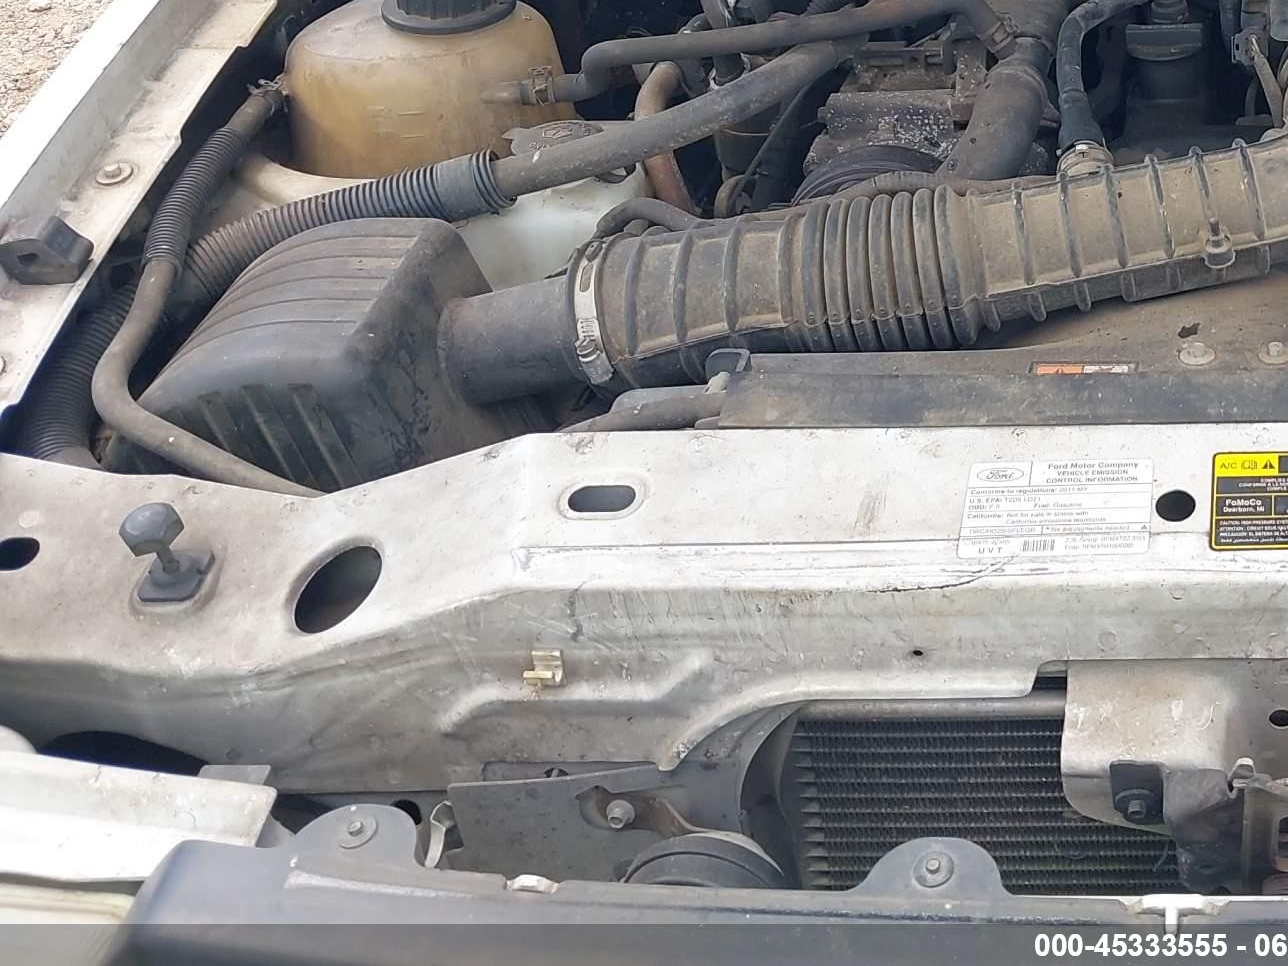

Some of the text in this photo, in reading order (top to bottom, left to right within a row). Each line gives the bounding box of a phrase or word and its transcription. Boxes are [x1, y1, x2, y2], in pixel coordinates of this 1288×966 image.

[1098, 462, 1139, 470] Company
[1219, 460, 1238, 469] A/C
[986, 468, 1014, 480] Ford
[1225, 498, 1262, 506] FoMoCo
